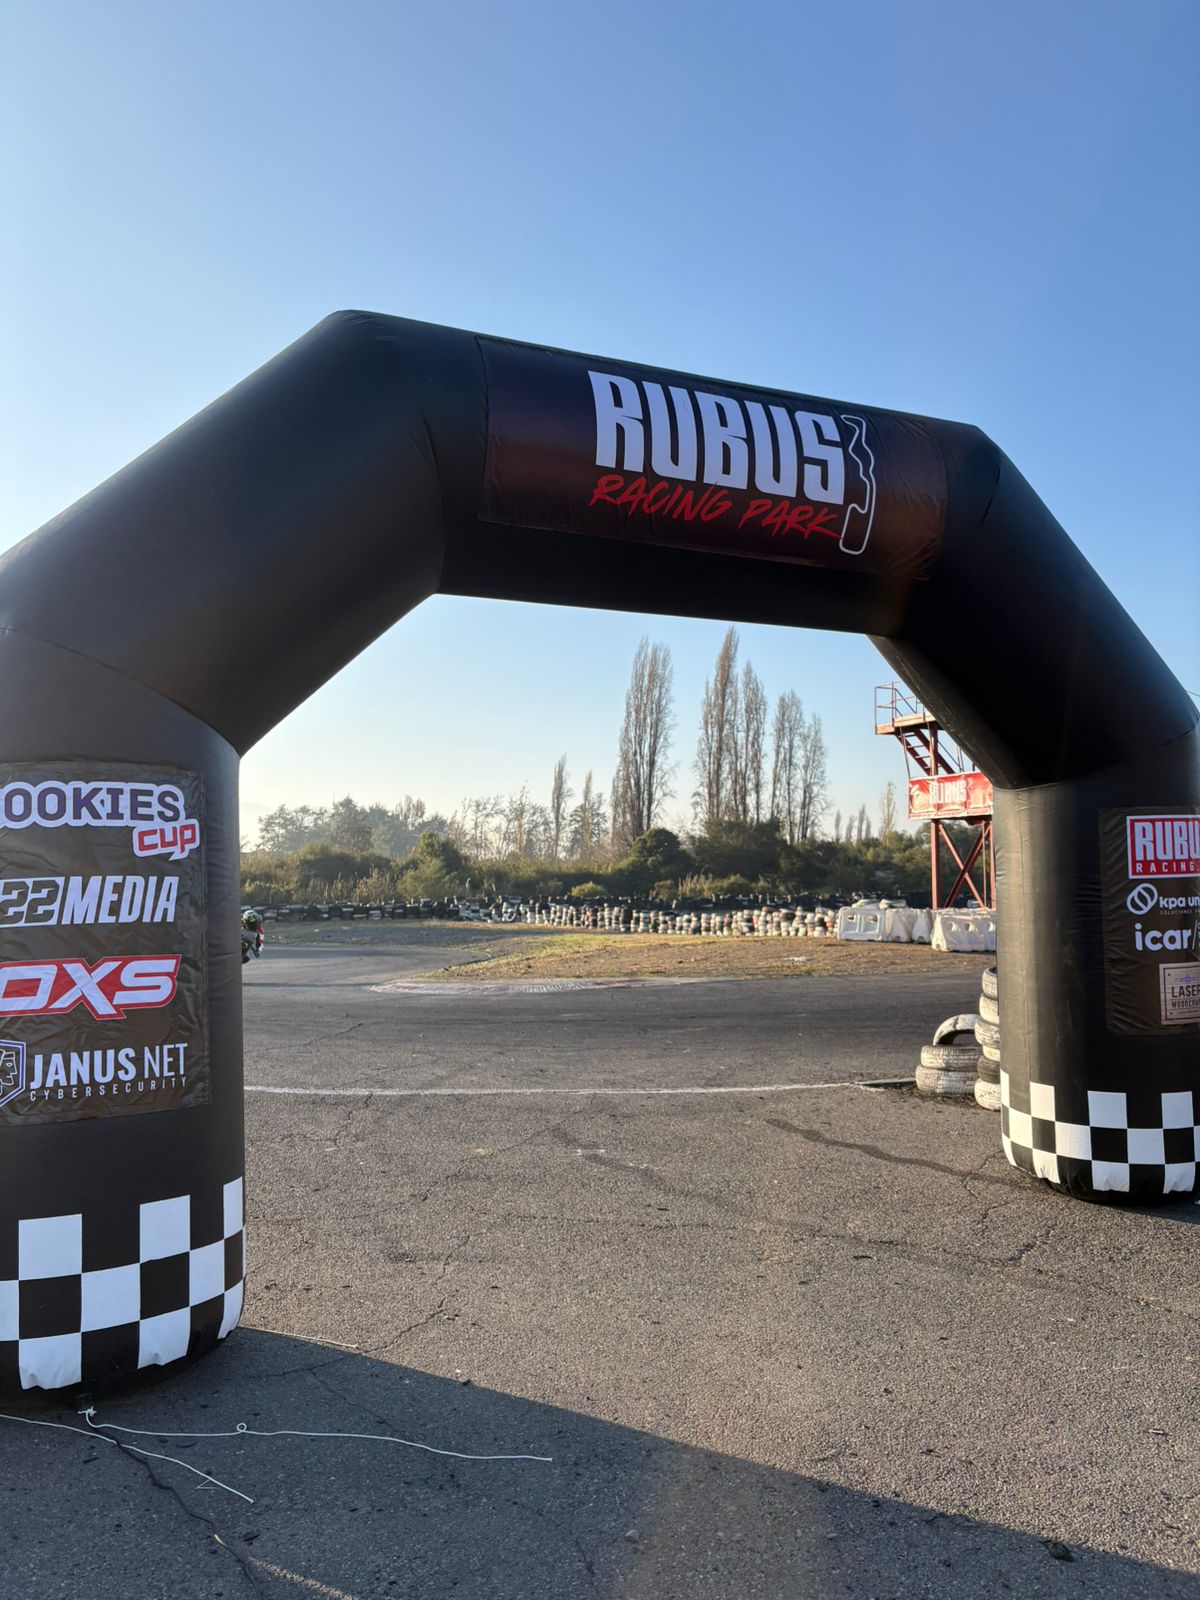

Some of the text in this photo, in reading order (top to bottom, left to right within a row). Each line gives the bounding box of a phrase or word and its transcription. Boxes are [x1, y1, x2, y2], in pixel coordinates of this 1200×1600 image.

[588, 370, 845, 505] RUBUS
[588, 474, 844, 539] RACING PARK
[1134, 821, 1200, 860] RUBU
[1159, 896, 1186, 910] kpa
[1135, 922, 1192, 951] icar
[30, 1042, 188, 1090] JANUS NET
[30, 1077, 188, 1102] CYBERSECURITY
